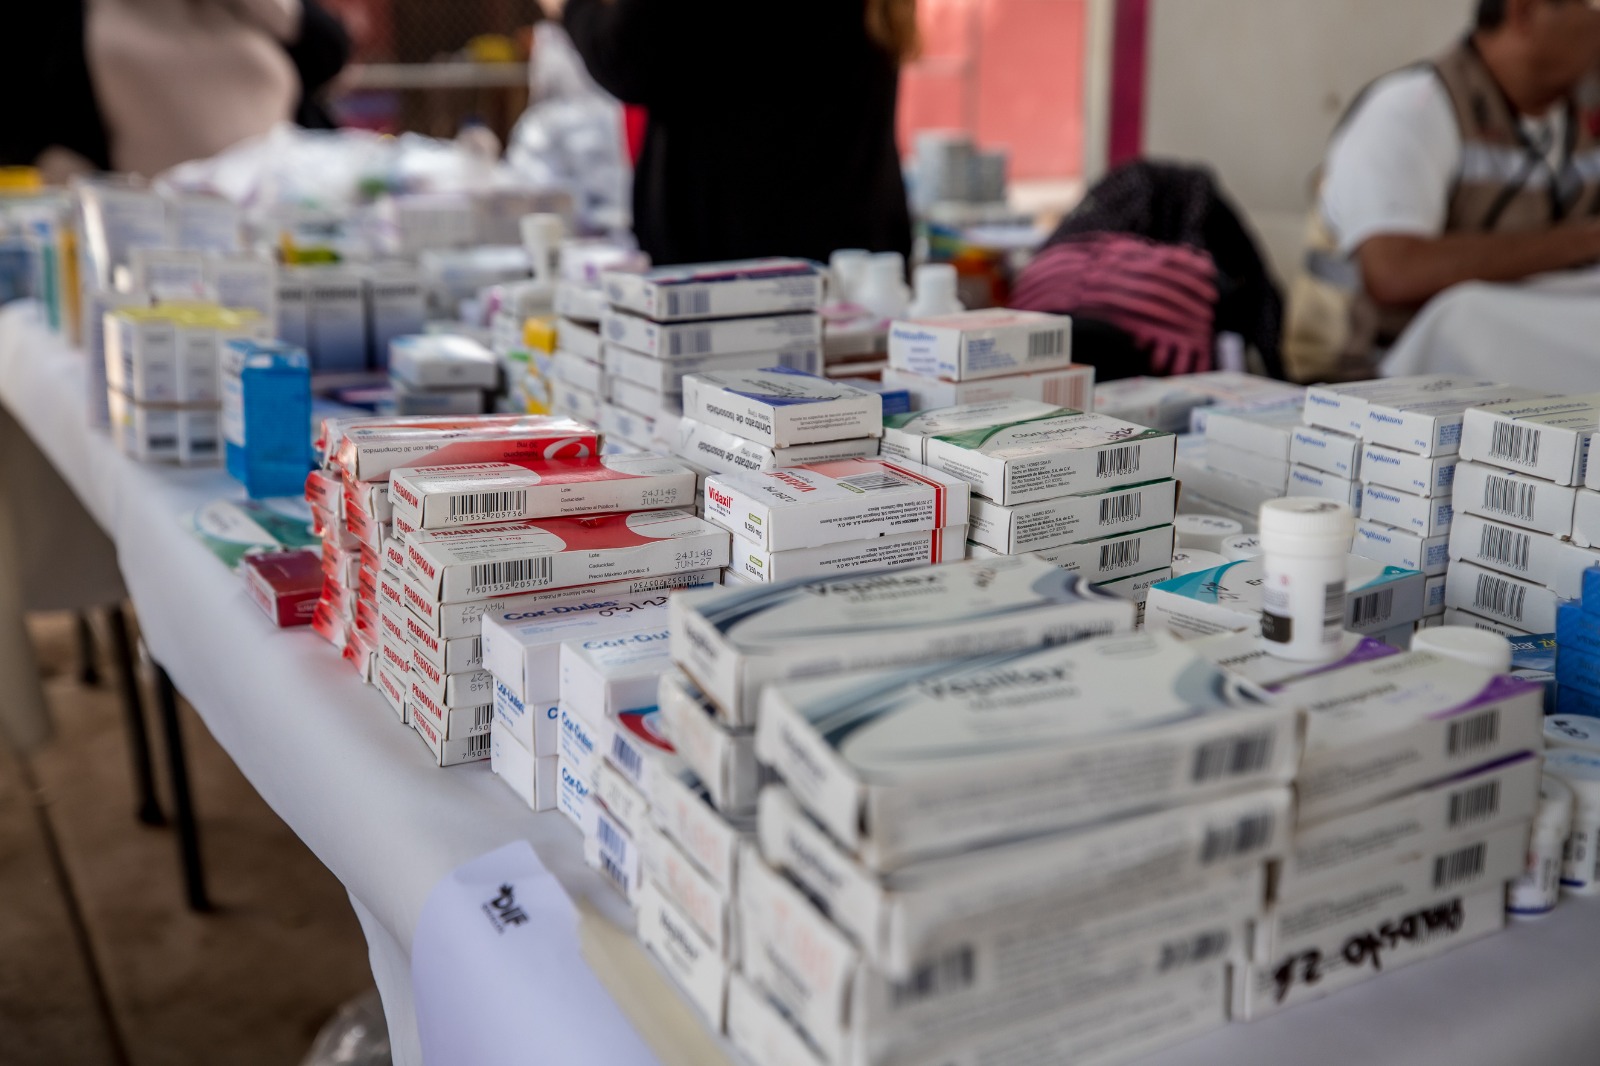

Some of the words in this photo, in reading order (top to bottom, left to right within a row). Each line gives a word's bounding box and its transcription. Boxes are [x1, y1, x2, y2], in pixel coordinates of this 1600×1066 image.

[706, 403, 735, 422] Isosorbida
[736, 415, 744, 424] de
[746, 418, 772, 435] Dinitrato
[362, 446, 402, 455] Comprimidos
[726, 451, 734, 460] de
[414, 462, 510, 474] PRABIOQUIM
[642, 488, 677, 498] 24J148
[708, 486, 732, 509] Vidaxil
[641, 496, 676, 506] JUN-27
[454, 514, 486, 523] 501552
[490, 510, 523, 518] 205736
[397, 517, 416, 532] PRABIO
[430, 524, 532, 537] PRABIOQUIM
[388, 547, 404, 568] PRABI
[675, 549, 713, 561] 24J148
[674, 558, 712, 569] JUN-27
[634, 580, 664, 588] 205736
[667, 575, 697, 583] 501552
[476, 583, 510, 593] 501552
[514, 579, 549, 588] 205736
[381, 581, 405, 607] PRABIOQ
[462, 602, 505, 615] MAY-27
[504, 600, 618, 621] Cor-Dulas
[407, 618, 438, 653] PRABIOQUIM
[583, 630, 672, 650] Cor-Du
[412, 683, 442, 721] PRABIOQUIM
